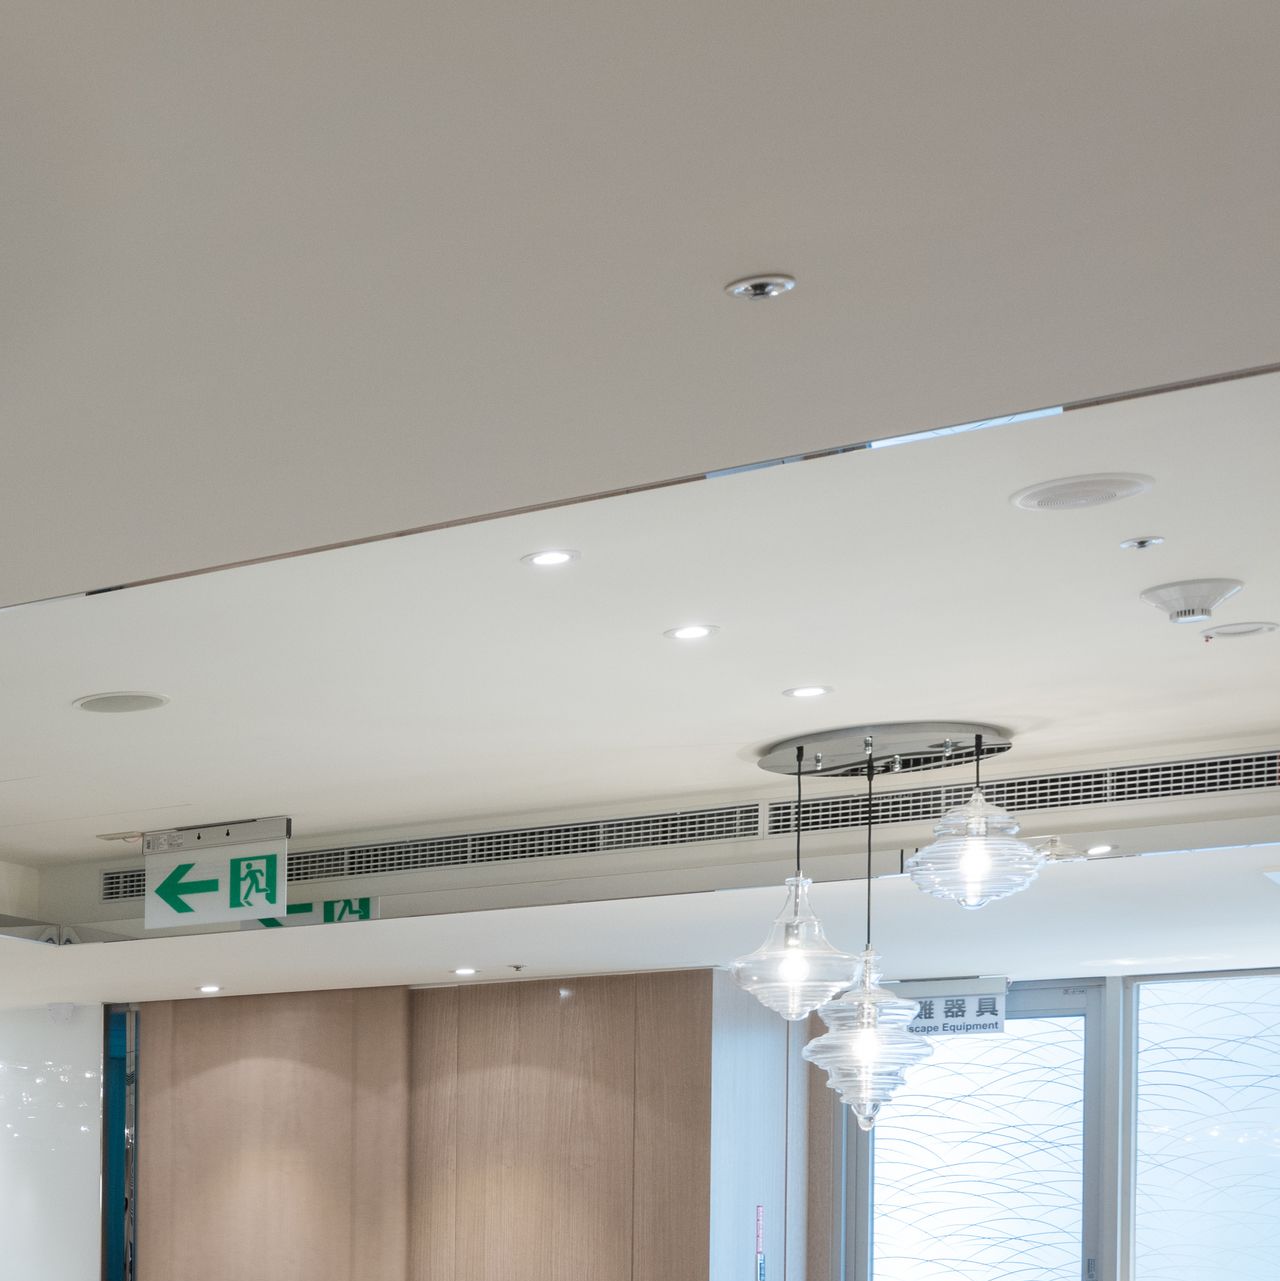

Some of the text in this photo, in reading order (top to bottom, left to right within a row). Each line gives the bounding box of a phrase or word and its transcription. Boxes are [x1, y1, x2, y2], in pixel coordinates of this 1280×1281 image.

[913, 997, 999, 1020] 難器具
[942, 1021, 999, 1033] Equipment
